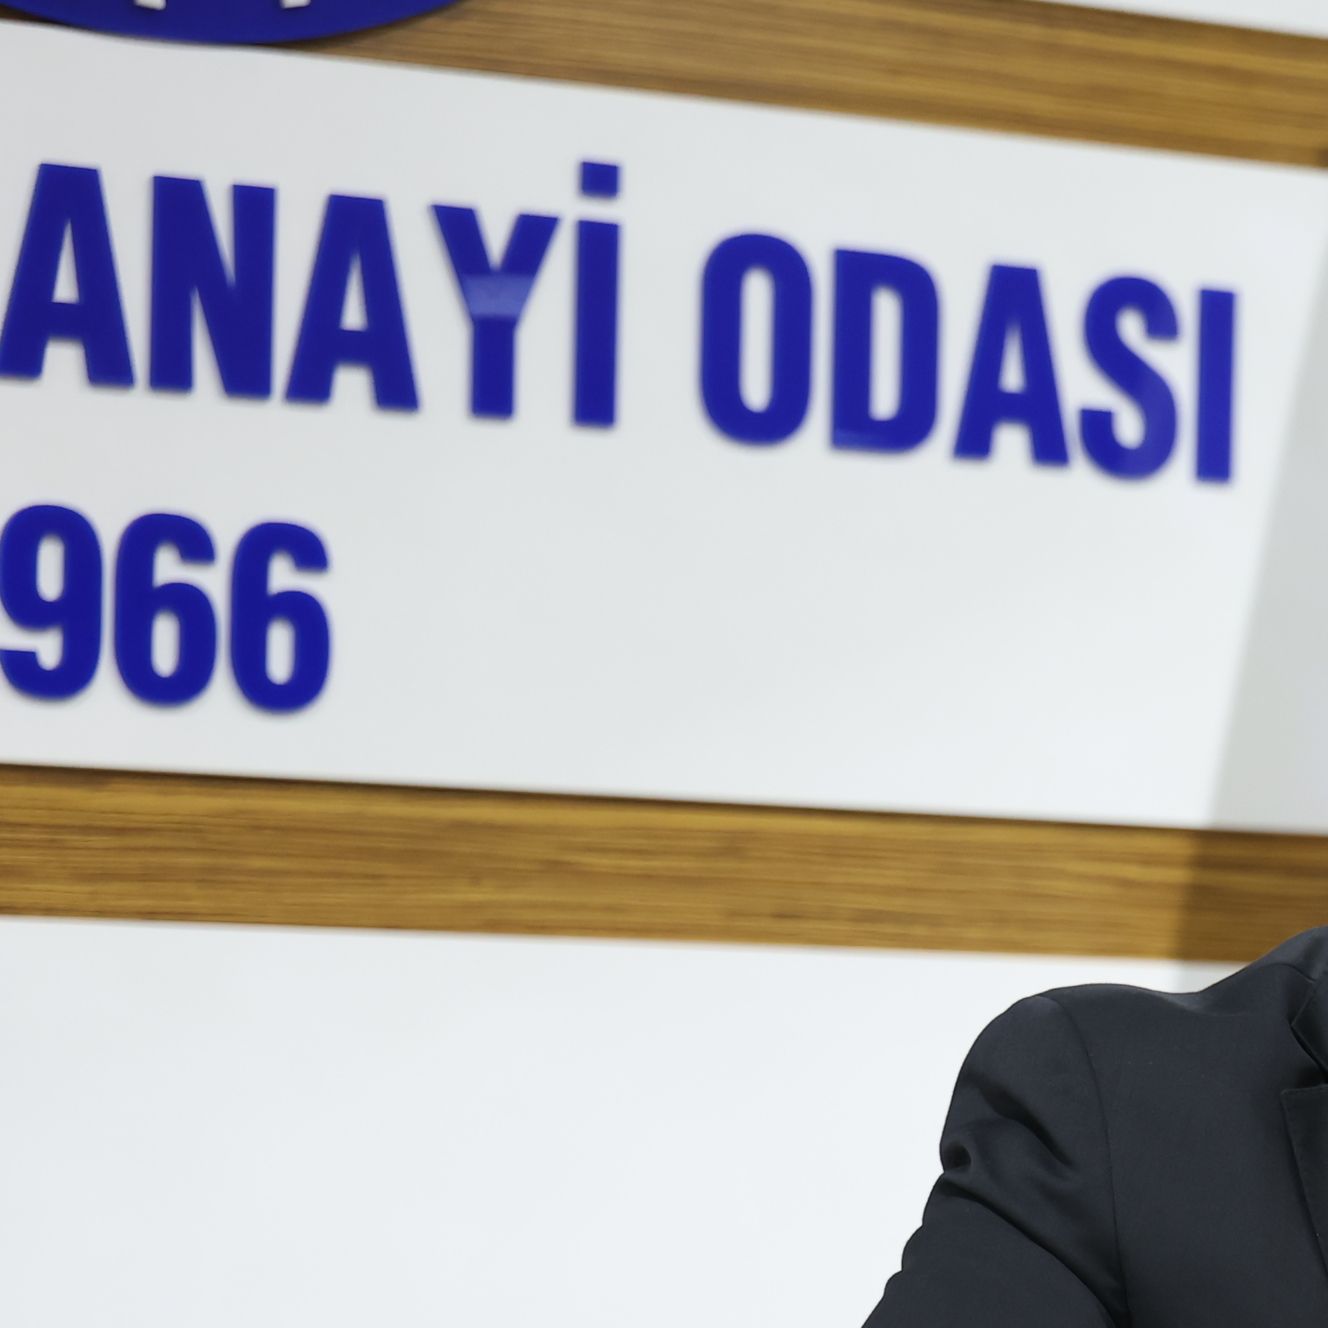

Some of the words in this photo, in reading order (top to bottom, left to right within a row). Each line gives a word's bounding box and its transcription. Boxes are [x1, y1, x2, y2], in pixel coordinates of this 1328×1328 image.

[0, 160, 621, 429] ANAYİ
[698, 232, 1236, 484] ODASI
[0, 504, 331, 715] 966
